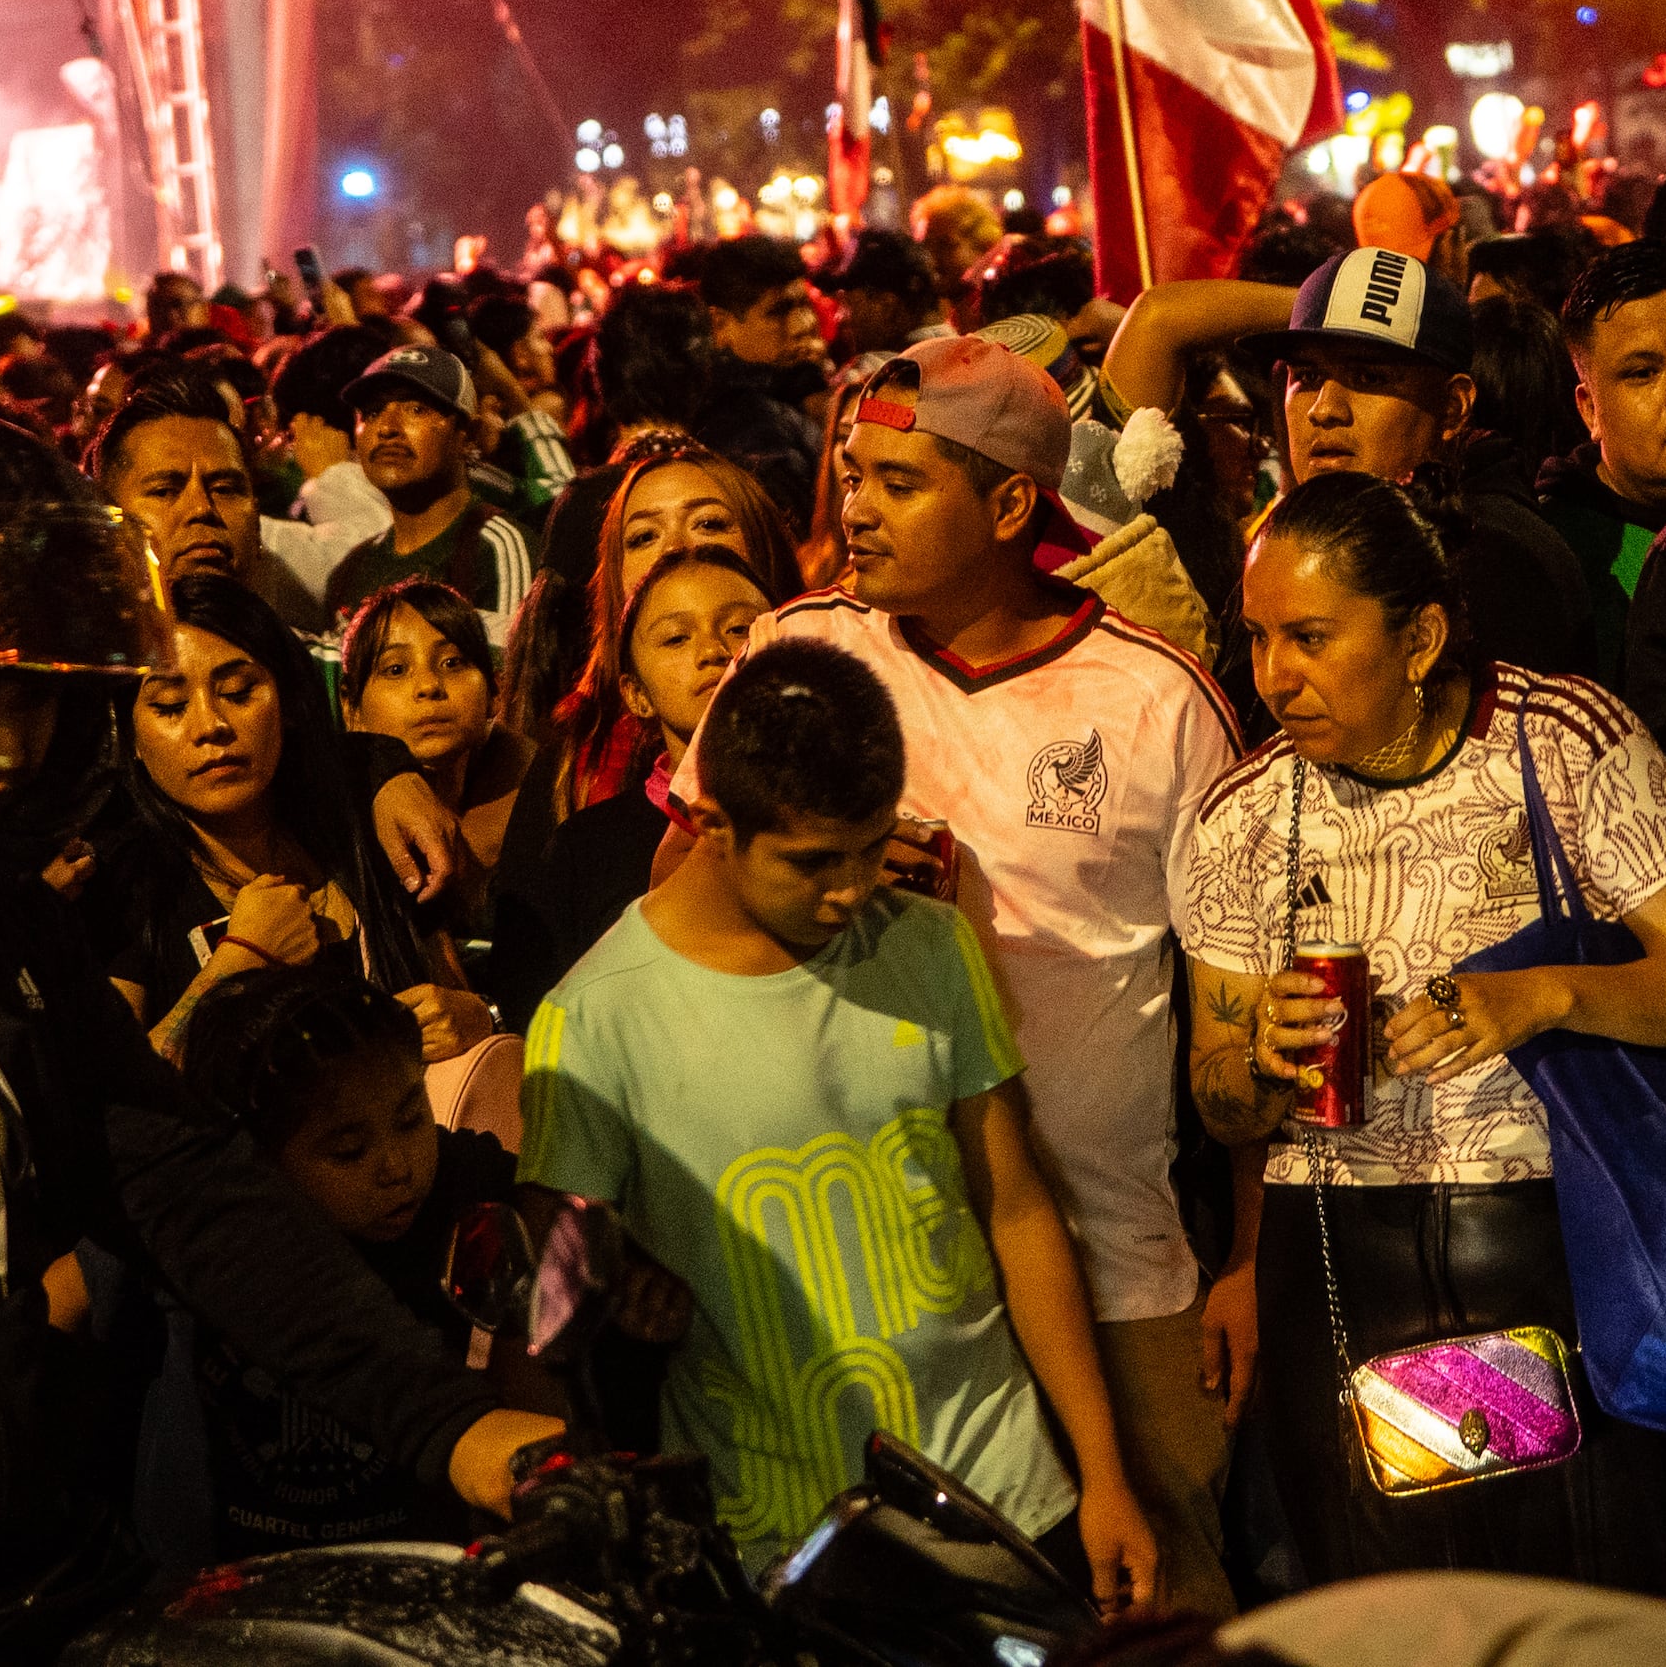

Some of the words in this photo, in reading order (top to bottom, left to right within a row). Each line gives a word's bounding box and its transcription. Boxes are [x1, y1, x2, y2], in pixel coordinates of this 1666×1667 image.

[1360, 249, 1409, 327] PUMA
[1030, 809, 1095, 830] MÉXICO
[274, 1481, 338, 1505] HONOR
[345, 1478, 357, 1496] Y
[228, 1505, 314, 1540] CUARTEL
[320, 1507, 408, 1540] GENERAL
